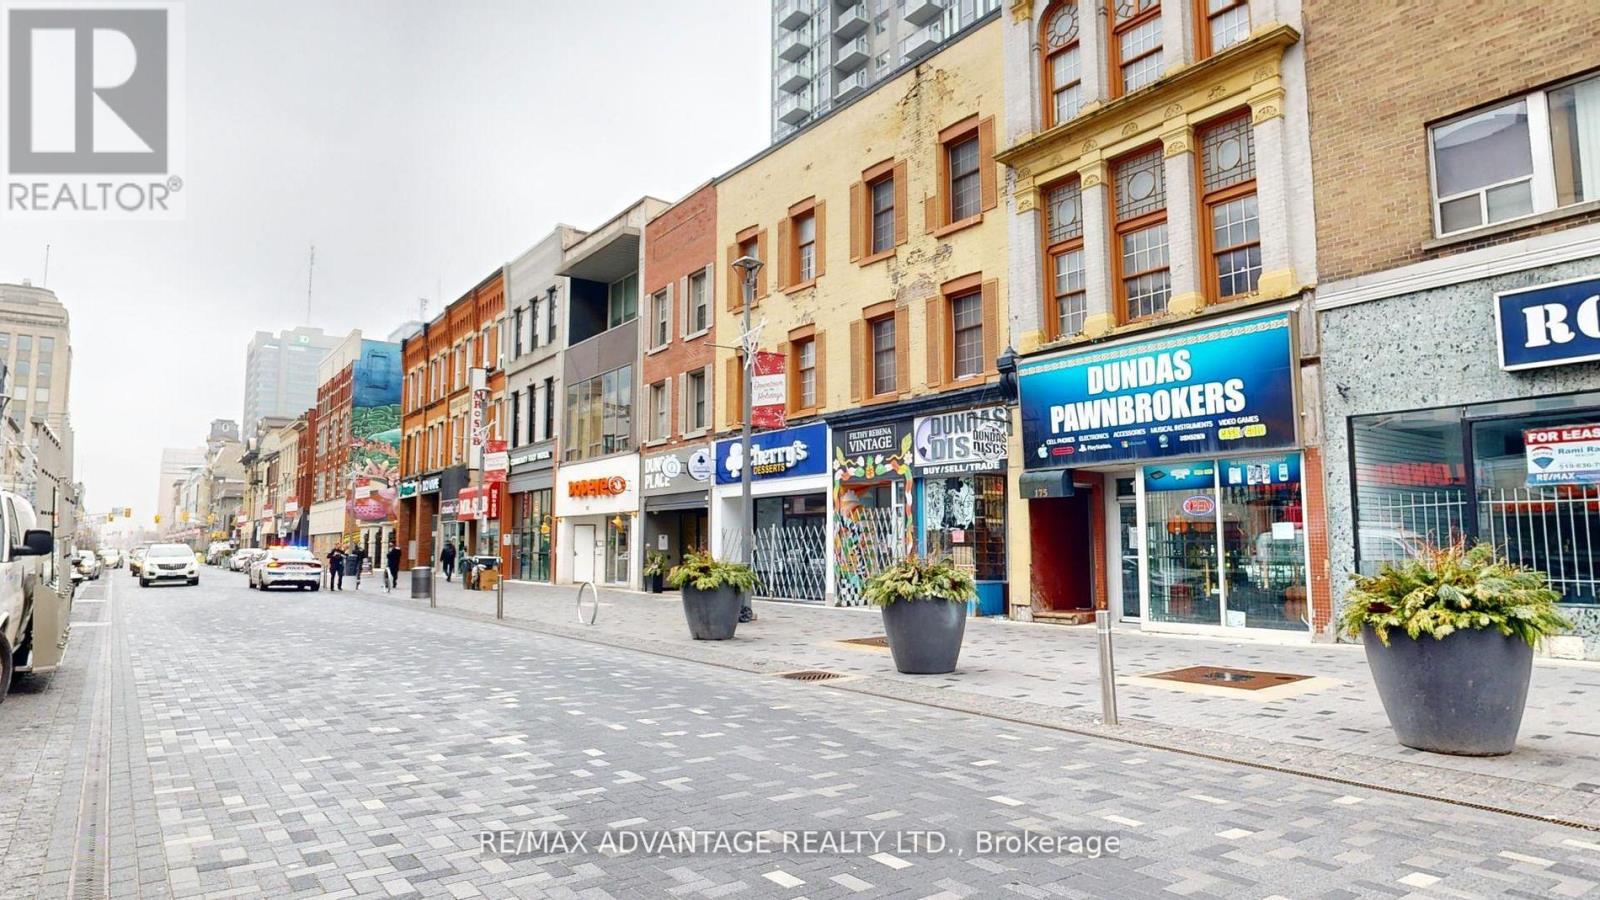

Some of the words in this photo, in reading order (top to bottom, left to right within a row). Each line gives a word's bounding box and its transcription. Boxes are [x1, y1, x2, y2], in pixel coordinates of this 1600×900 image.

[1087, 349, 1193, 395] DUNDAS
[1050, 378, 1246, 434] PAWNBROKERS
[1218, 418, 1236, 426] VIDEO
[1237, 415, 1259, 424] GAMES
[1528, 431, 1559, 443] FOR
[849, 436, 893, 453] VINTAGE
[972, 441, 1007, 456] DISCS
[751, 440, 808, 468] herry's
[753, 463, 785, 475] DESSERTS
[923, 461, 1000, 475] BUY/SELL/TRADE
[1536, 472, 1575, 482] RE/MAX
